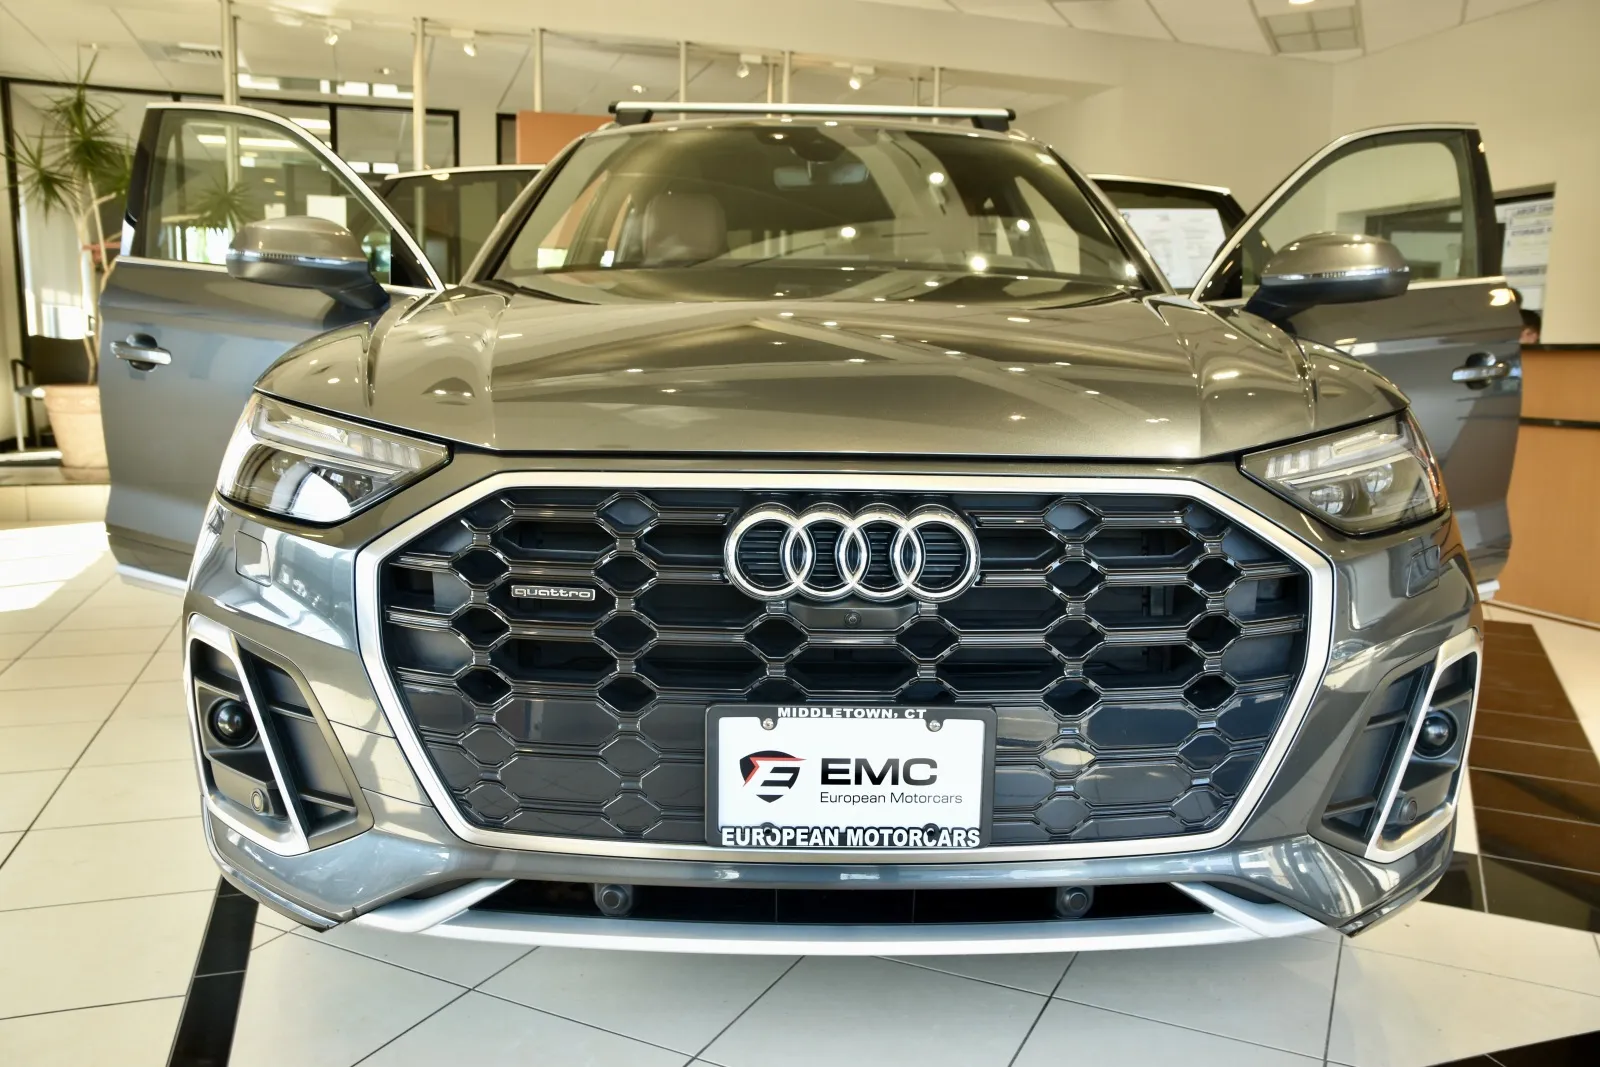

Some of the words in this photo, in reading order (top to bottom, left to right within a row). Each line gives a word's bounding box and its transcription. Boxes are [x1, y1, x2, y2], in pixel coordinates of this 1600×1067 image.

[514, 588, 591, 598] quattro
[777, 707, 899, 719] MIDDLETOWN,
[904, 708, 927, 719] CT
[820, 757, 938, 786] EMC
[820, 791, 886, 805] European
[890, 792, 963, 804] Motorcars
[721, 828, 843, 847] EUROPEAN
[846, 829, 981, 847] MOTORCARS
